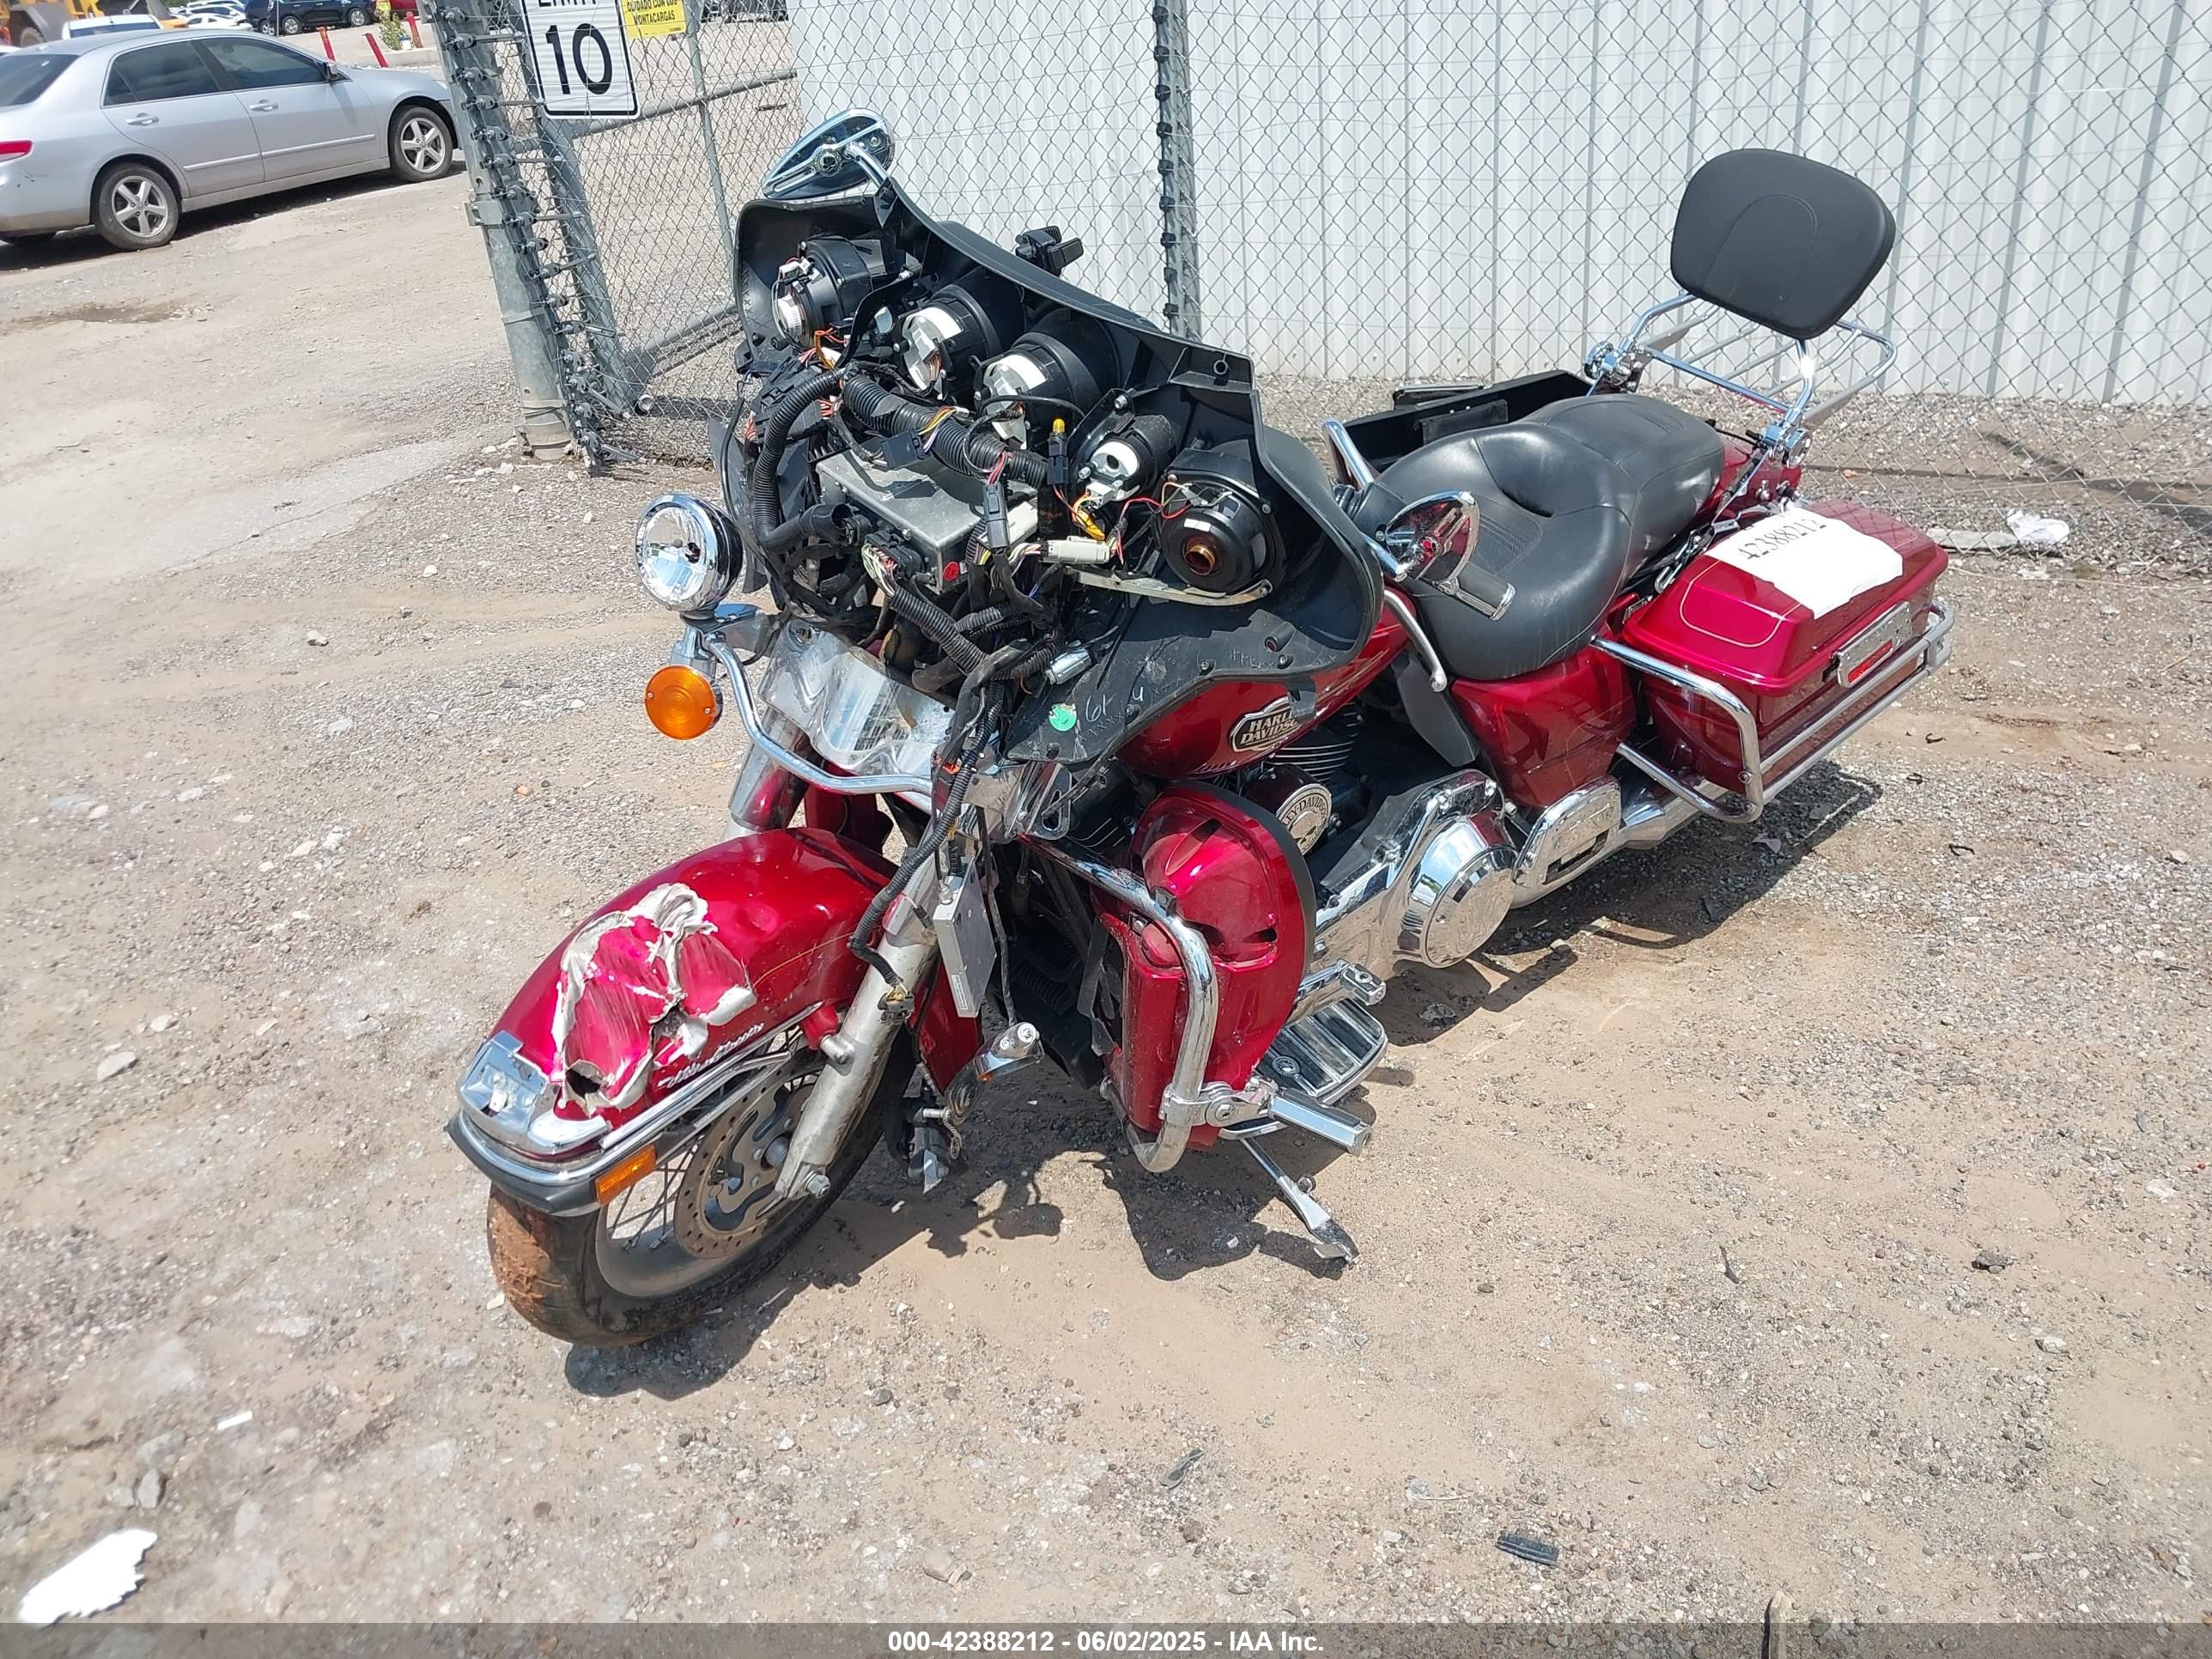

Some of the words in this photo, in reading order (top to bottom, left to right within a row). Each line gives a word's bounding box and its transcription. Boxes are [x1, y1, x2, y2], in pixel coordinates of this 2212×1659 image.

[545, 23, 612, 94] 10
[1738, 519, 1826, 559] 42388212
[1240, 719, 1297, 744] DAVIDS
[1249, 710, 1294, 732] HARL
